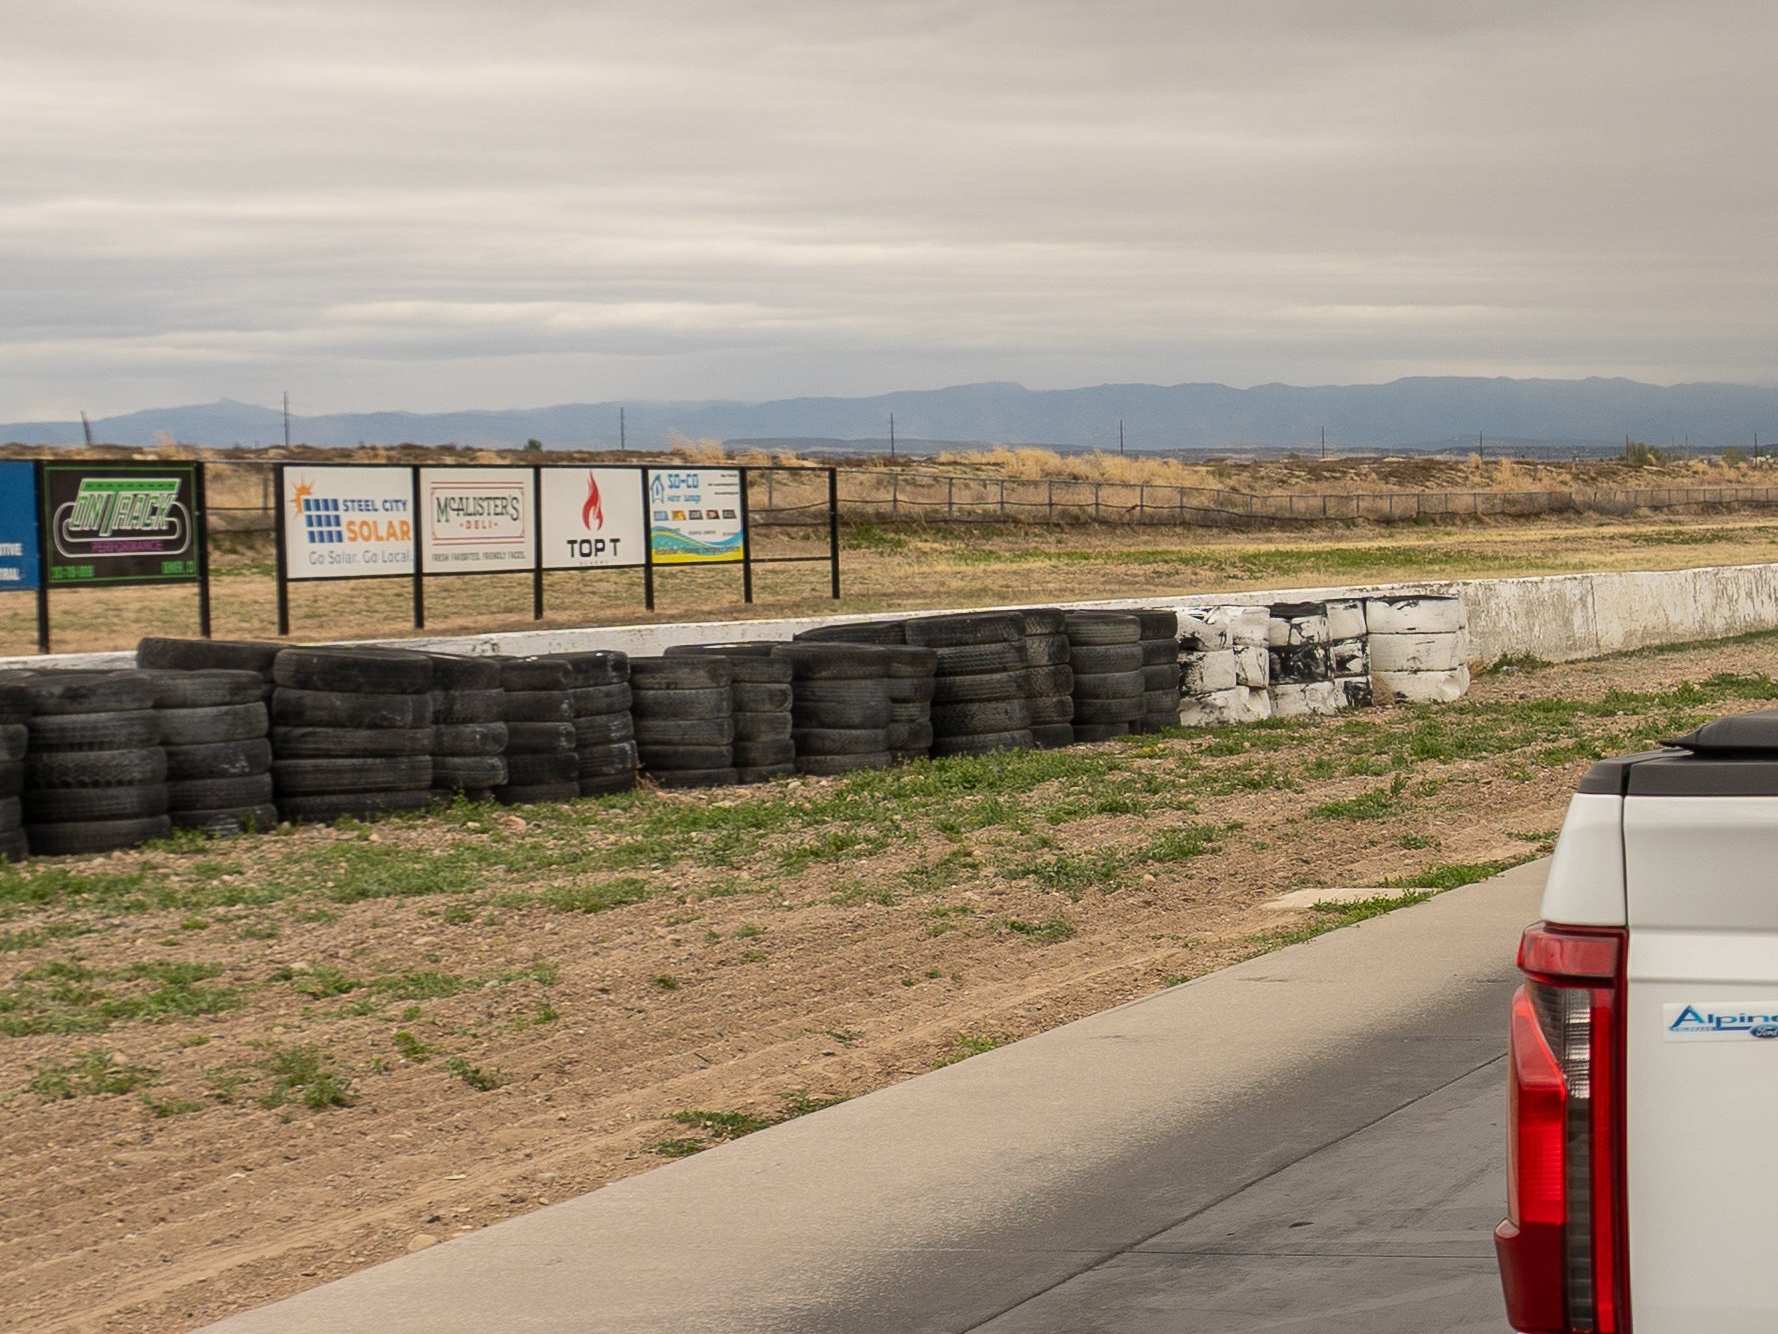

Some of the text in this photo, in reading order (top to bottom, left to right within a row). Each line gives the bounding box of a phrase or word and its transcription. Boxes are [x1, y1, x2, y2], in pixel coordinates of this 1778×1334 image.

[342, 499, 408, 512] STEEL CITY
[346, 520, 411, 542] SOLAR
[466, 520, 493, 530] DELI
[566, 538, 621, 557] TOP T
[309, 551, 324, 565] Go
[362, 550, 377, 563] Go
